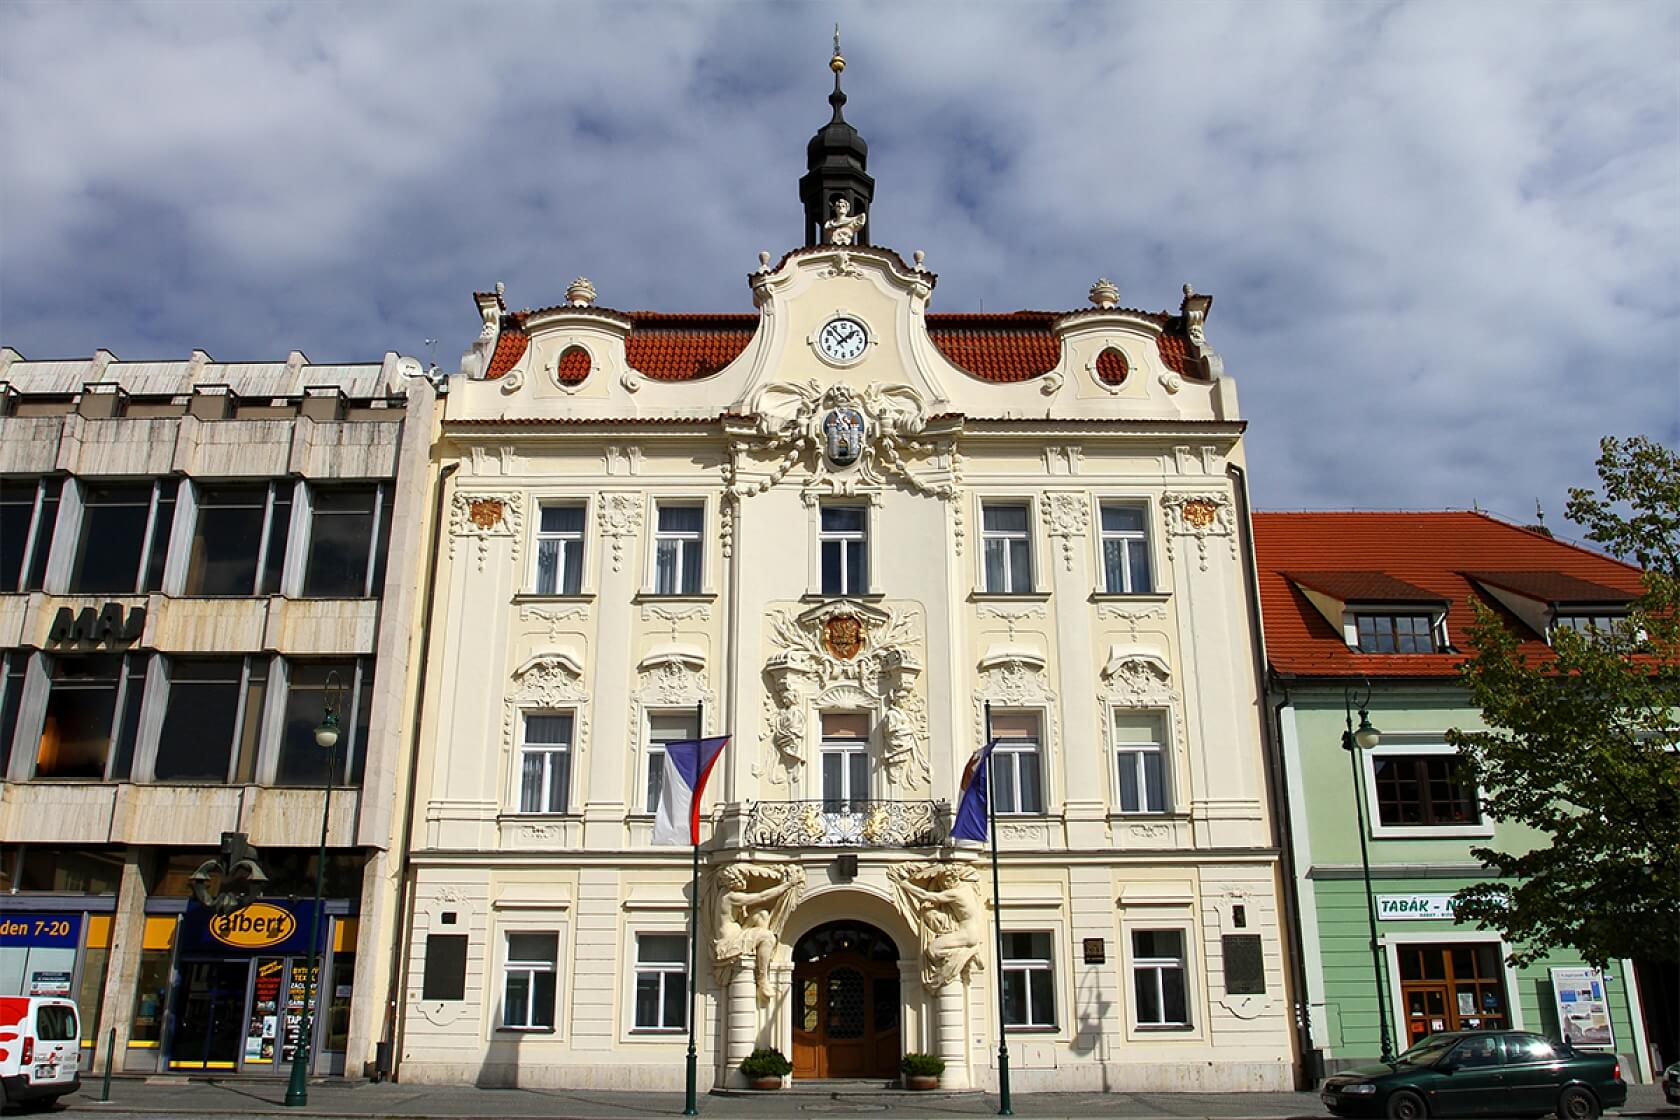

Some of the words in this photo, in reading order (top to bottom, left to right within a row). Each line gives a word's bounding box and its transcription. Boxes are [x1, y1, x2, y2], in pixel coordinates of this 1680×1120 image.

[1382, 897, 1429, 912] TABÁK
[34, 920, 70, 936] 7-20
[218, 912, 288, 933] albert
